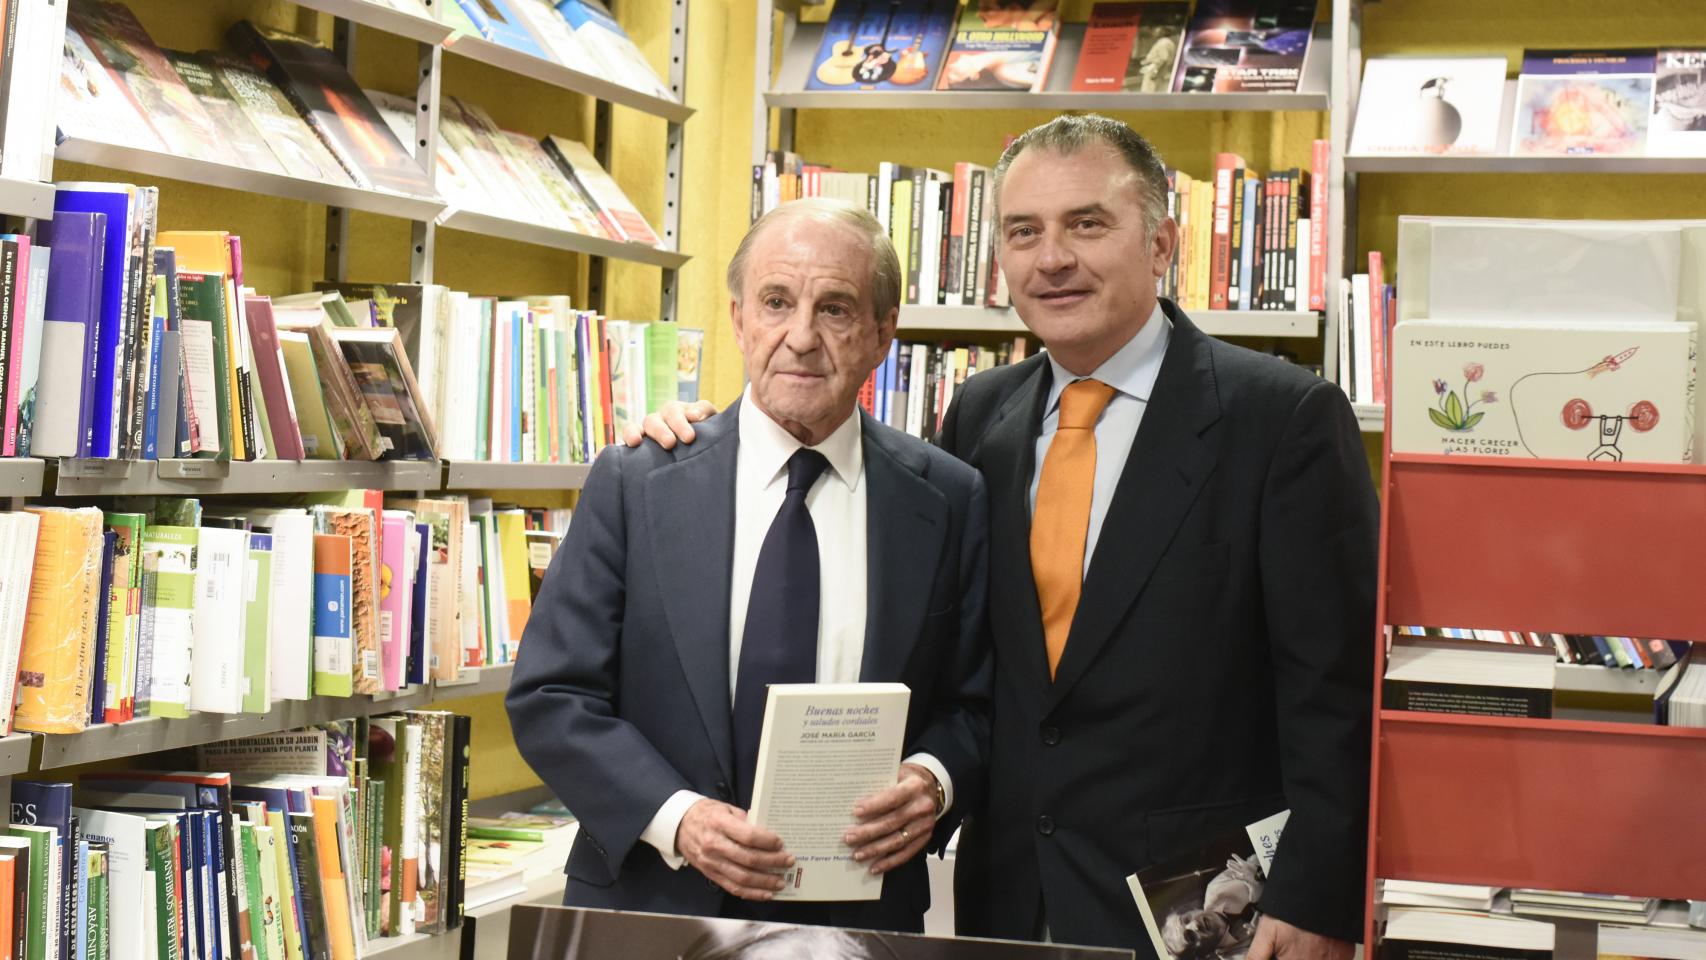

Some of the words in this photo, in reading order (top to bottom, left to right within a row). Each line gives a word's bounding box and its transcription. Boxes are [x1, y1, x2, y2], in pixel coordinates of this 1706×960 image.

[1260, 68, 1299, 76] TREK
[6, 251, 13, 260] EL
[3, 274, 11, 285] DE
[3, 286, 10, 295] LA
[1, 296, 9, 328] CIENCIA
[1448, 341, 1475, 349] LIBRO
[1478, 342, 1511, 350] PUEDES
[136, 395, 144, 425] ALDRIN
[1442, 437, 1476, 446] HACER
[1480, 438, 1519, 447] CRECER
[1472, 447, 1510, 456] FLORES
[805, 705, 843, 716] Buenas
[846, 705, 880, 715] noches
[254, 746, 278, 754] PLANTA
[295, 745, 318, 753] PLANTA
[460, 799, 468, 848] UNIVERSO
[86, 834, 115, 844] enanos
[458, 849, 466, 881] VERDE
[164, 860, 174, 911] ANFIBIOS
